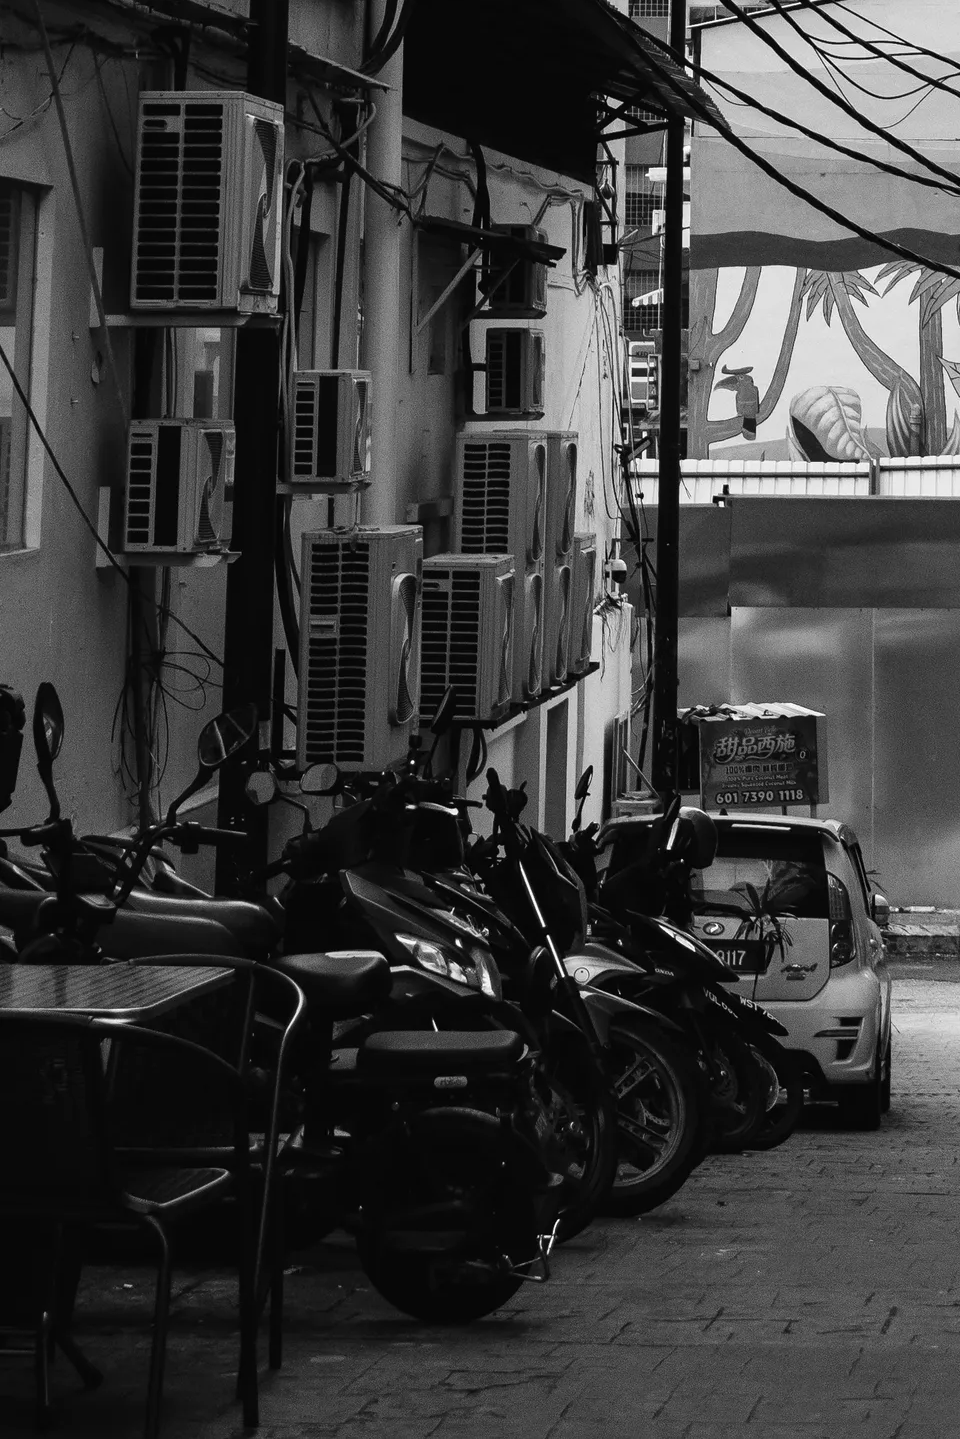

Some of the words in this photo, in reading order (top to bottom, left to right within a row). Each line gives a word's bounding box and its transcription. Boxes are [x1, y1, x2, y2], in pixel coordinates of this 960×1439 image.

[716, 792, 738, 804] 601
[743, 790, 774, 803] 7390
[779, 789, 804, 801] 1118
[654, 968, 675, 977] ONDA
[740, 995, 758, 1011] WST
